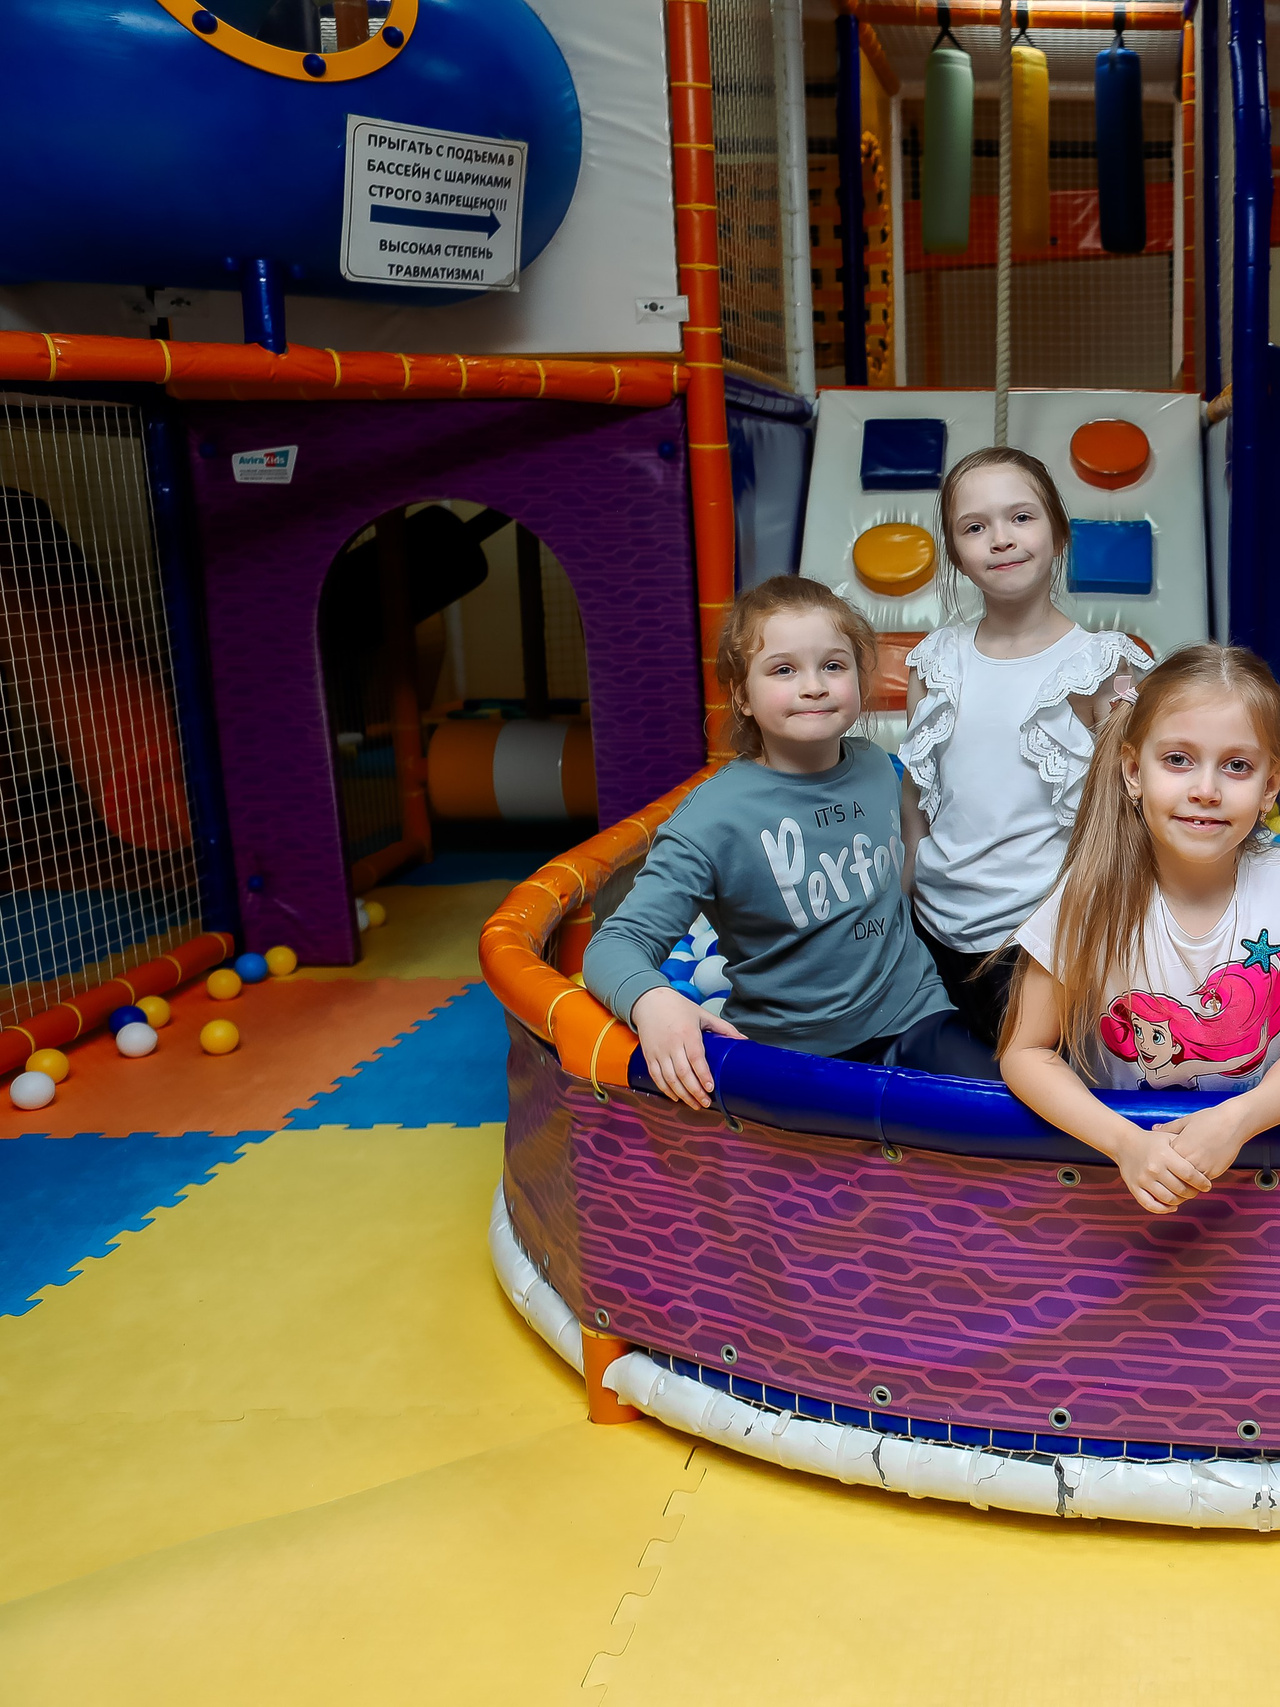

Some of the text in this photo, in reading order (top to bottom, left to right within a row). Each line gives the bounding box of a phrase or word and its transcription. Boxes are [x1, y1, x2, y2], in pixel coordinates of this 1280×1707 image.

[367, 134, 514, 167] ПРЫГАТЬ С ПОДЪЕМА В
[367, 159, 512, 190] БАССЕЙН С ШАРИКАМИ
[368, 184, 508, 212] СТРОГО ЗАПРЕЩЕНО!!!
[379, 239, 493, 260] ВЫСОКАЯ СТЕПЕНЬ
[387, 264, 484, 281] ТРАВМАТИЗМА!
[814, 800, 866, 828] IT'S A
[760, 810, 904, 929] Perfe
[854, 917, 886, 941] DAY
